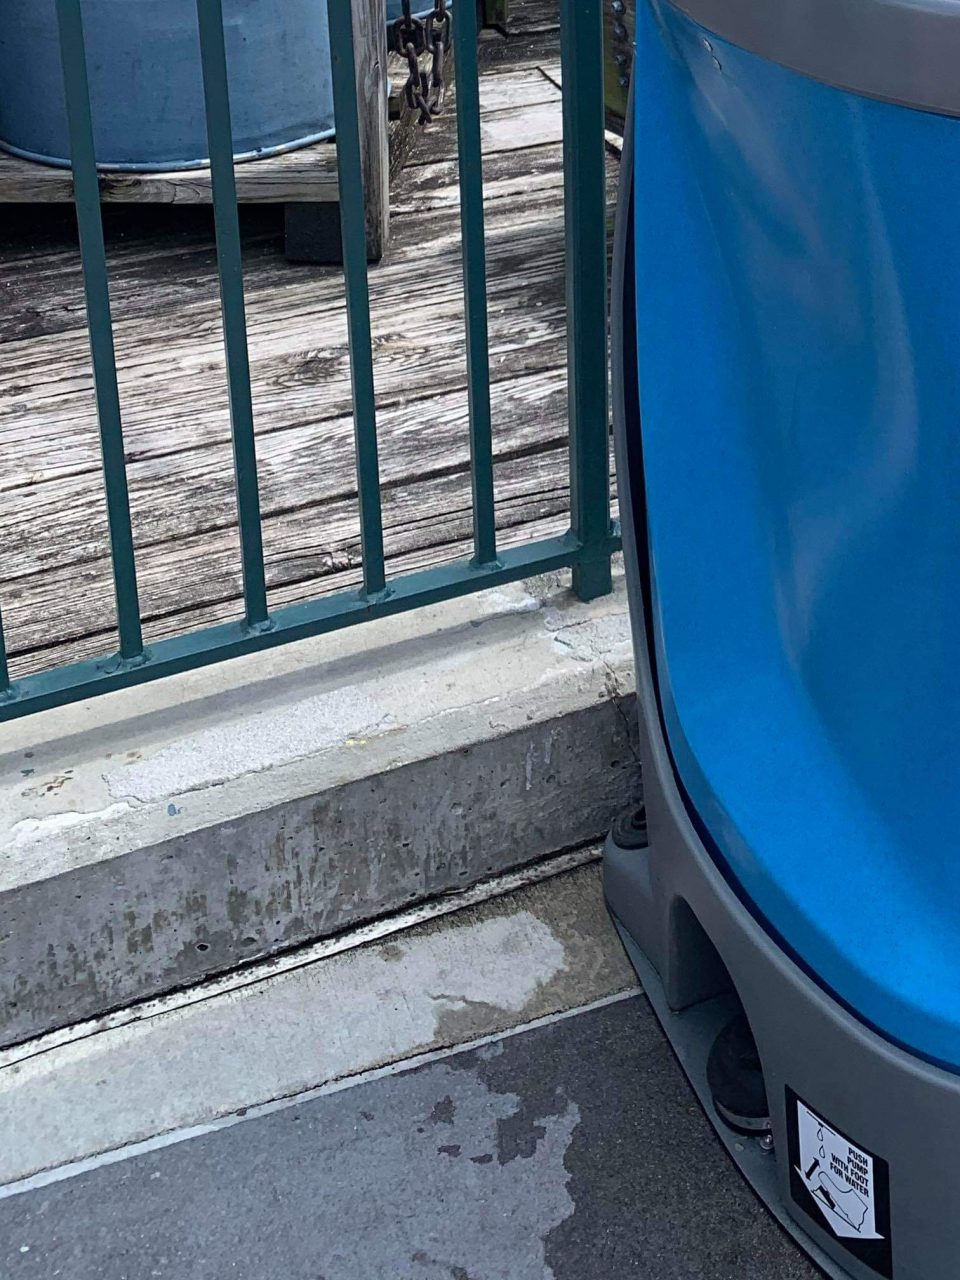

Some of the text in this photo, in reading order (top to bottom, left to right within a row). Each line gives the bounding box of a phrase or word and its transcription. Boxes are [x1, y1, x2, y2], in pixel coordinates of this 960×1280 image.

[831, 1153, 869, 1187] WITH FOOT
[847, 1156, 868, 1176] PUMP
[848, 1147, 868, 1167] PUSH
[830, 1162, 869, 1198] FOR WATER
